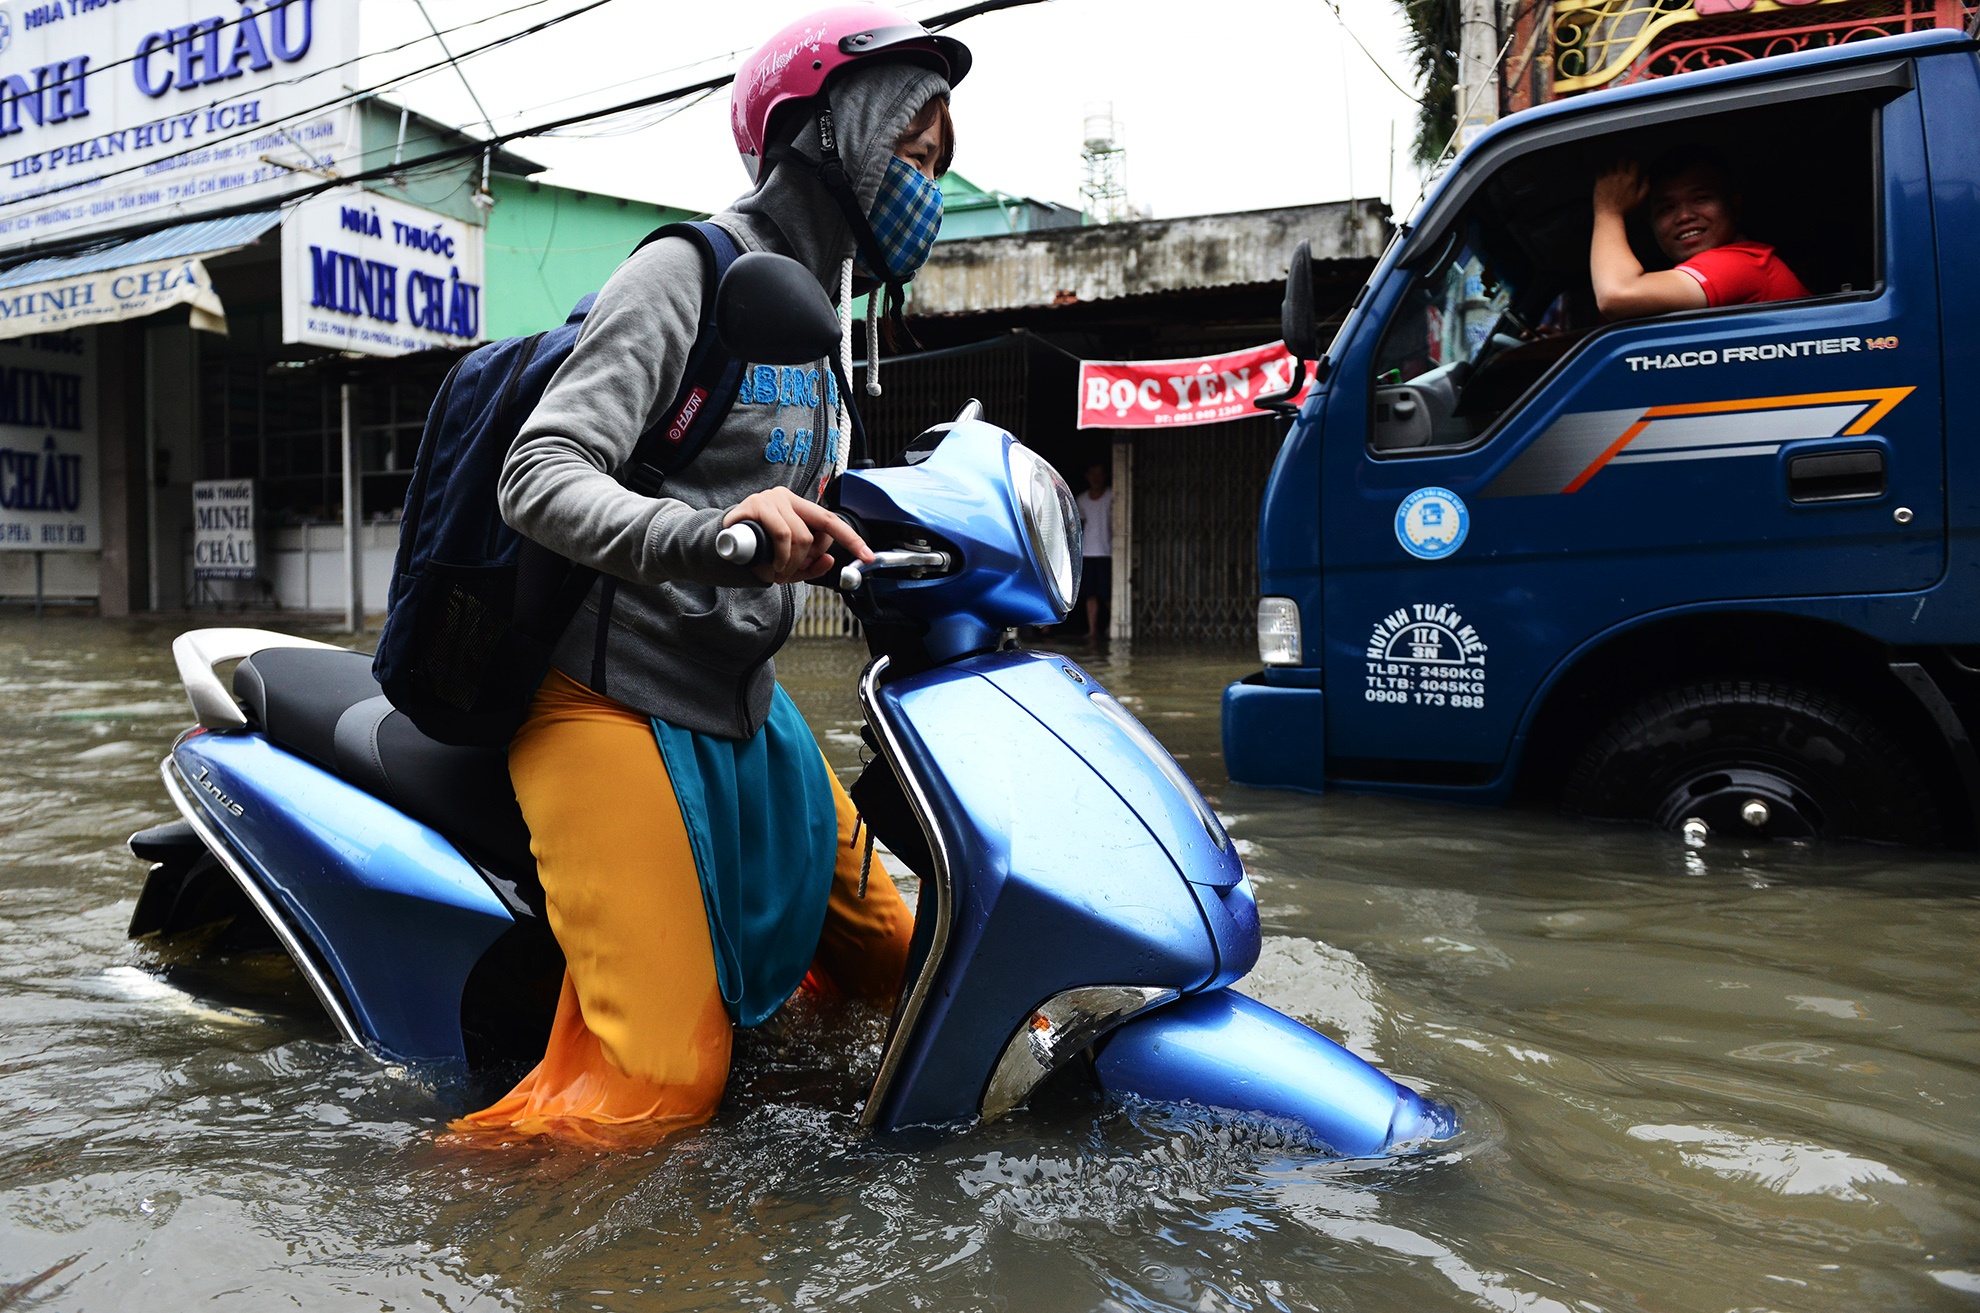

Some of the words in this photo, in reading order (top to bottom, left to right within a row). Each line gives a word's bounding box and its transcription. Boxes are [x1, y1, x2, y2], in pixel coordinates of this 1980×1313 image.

[11, 154, 43, 179] 115
[48, 130, 126, 169] PHAN
[133, 115, 198, 150] HUY
[340, 205, 382, 240] NHÀ
[392, 221, 455, 260] THUỐC
[309, 245, 398, 324] MINH
[406, 265, 480, 340] CHÂU
[1625, 349, 1718, 373] THACO
[1722, 335, 1862, 364] FRONTIER
[1864, 335, 1899, 351] 140
[1084, 377, 1163, 419] BỌC
[1167, 363, 1251, 411] YÊN
[765, 427, 790, 463] &
[197, 505, 251, 529] MINH
[195, 532, 251, 563] CHÂU
[1366, 607, 1410, 660] HUỲNH
[1412, 603, 1462, 630] TUẤN
[1457, 624, 1488, 666] KIỆT
[1412, 628, 1440, 644] 1T4
[1366, 662, 1416, 677] TLBT:
[1419, 666, 1486, 681] 2450KG
[1366, 676, 1416, 690] TLTB:
[1419, 679, 1485, 695] 4045KG
[1364, 688, 1408, 704] 0908
[1413, 692, 1446, 707] 173
[1450, 694, 1485, 709] 888
[192, 766, 244, 818] Janus
